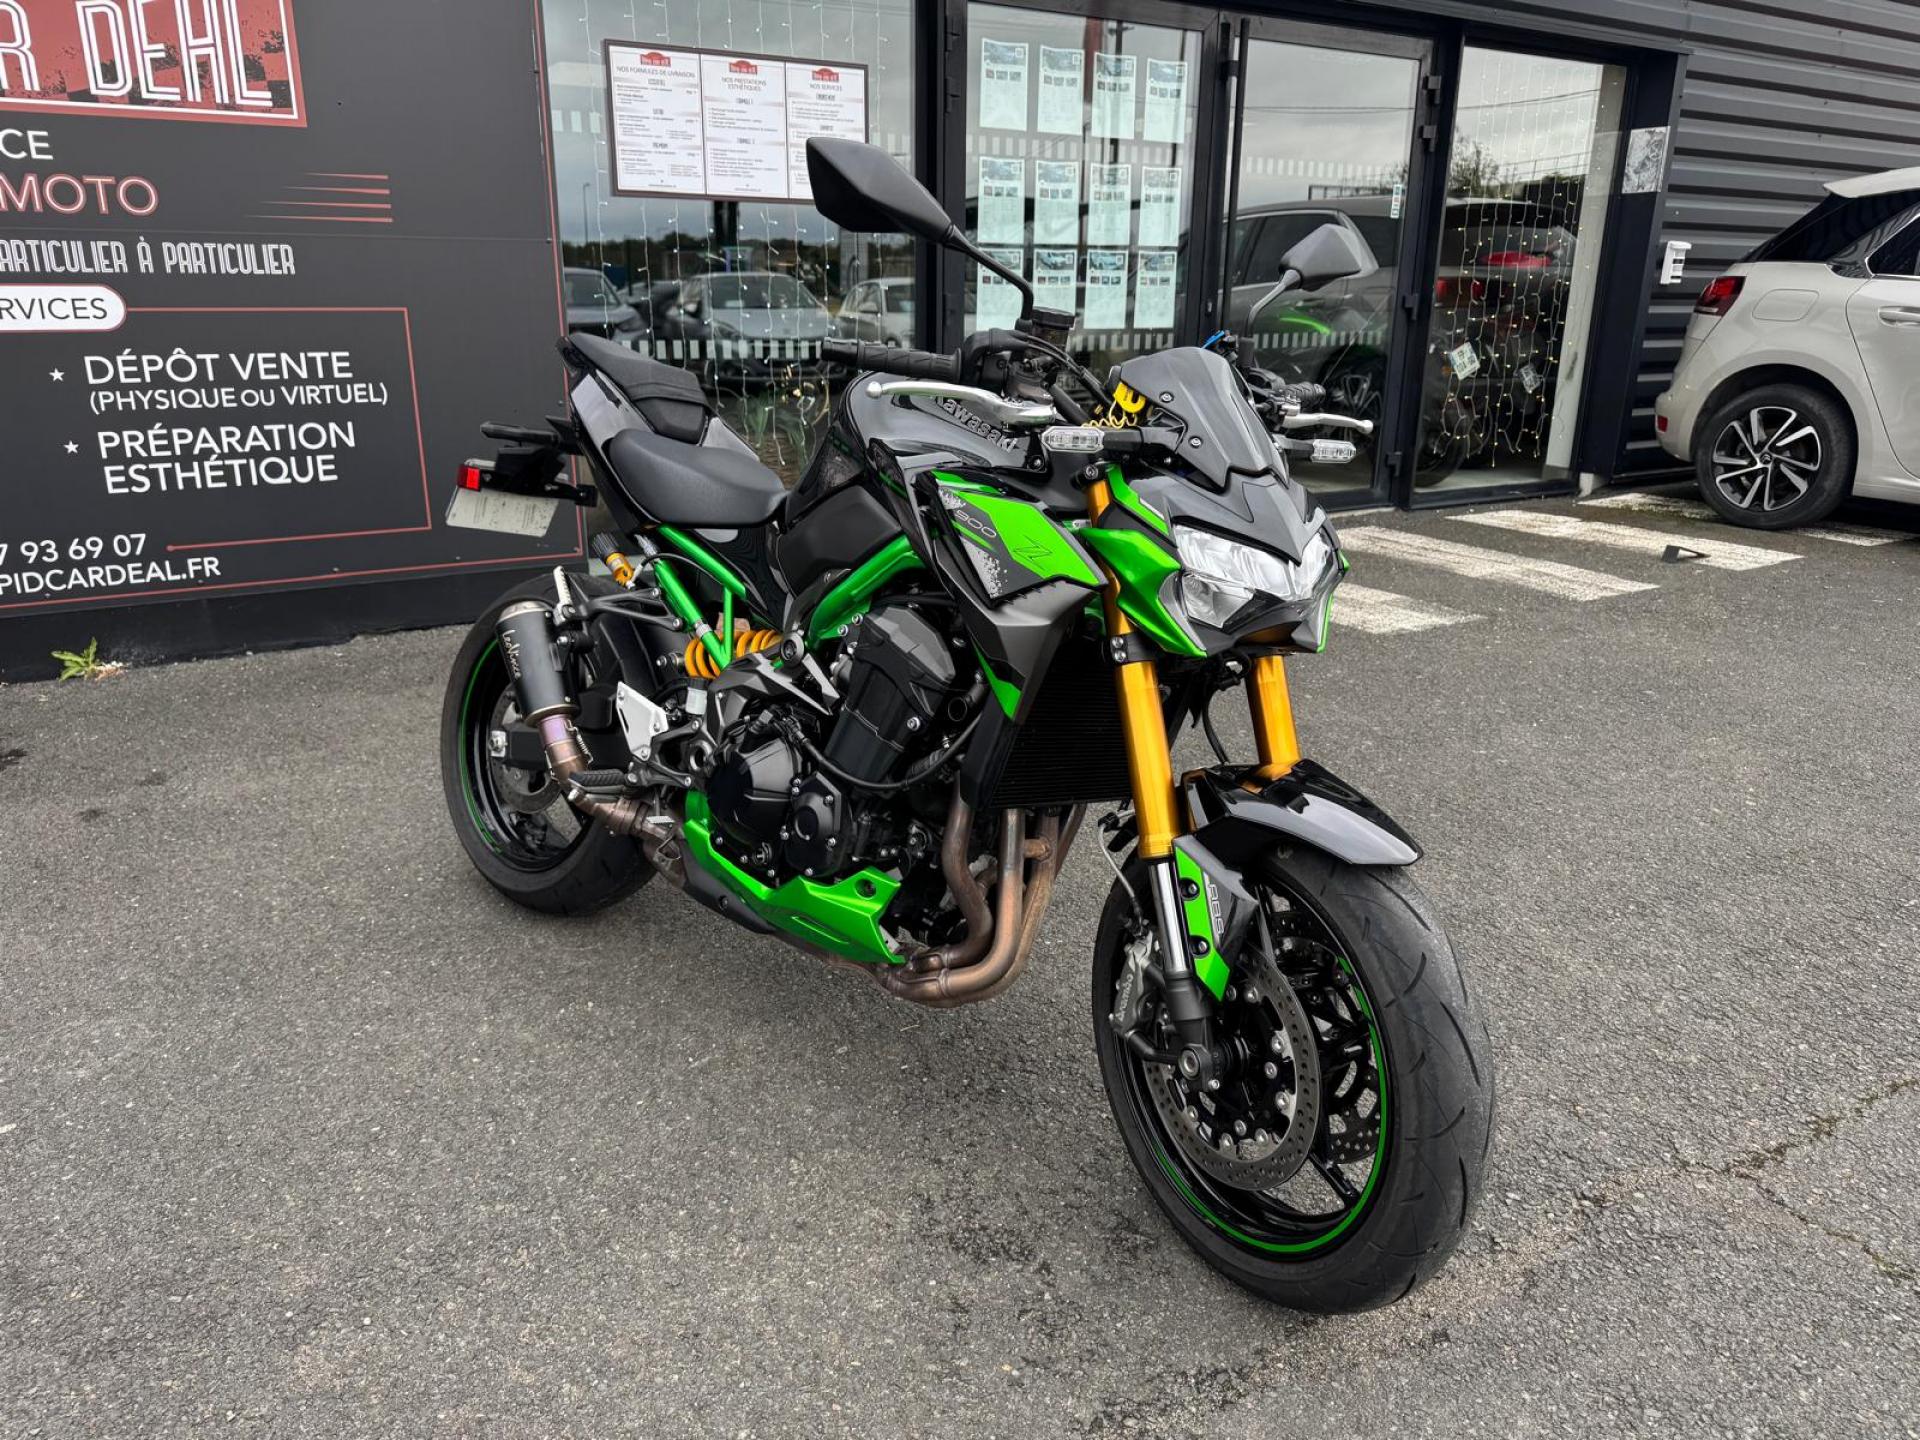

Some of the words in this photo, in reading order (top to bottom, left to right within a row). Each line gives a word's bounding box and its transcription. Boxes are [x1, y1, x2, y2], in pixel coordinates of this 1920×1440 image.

[0, 128, 53, 160] CE
[0, 173, 159, 216] MOTO
[136, 235, 154, 273] À
[161, 241, 296, 275] PARTICULIER
[0, 297, 108, 320] RVICES
[84, 347, 220, 385] DÉPÔT
[229, 351, 353, 381] VENTE
[89, 387, 238, 415] (PHYSIQUE
[240, 388, 275, 407] OU
[281, 382, 388, 405] VIRTUEL)
[97, 421, 356, 459] PRÉPARATION
[103, 454, 338, 495] ESTHÉTIQUE
[955, 509, 997, 539] 900
[20, 539, 59, 564] 93
[68, 536, 103, 560] 69
[113, 533, 146, 557] 07
[0, 556, 221, 595] PIDCARDEAL.FR
[1208, 883, 1225, 935] ABS
